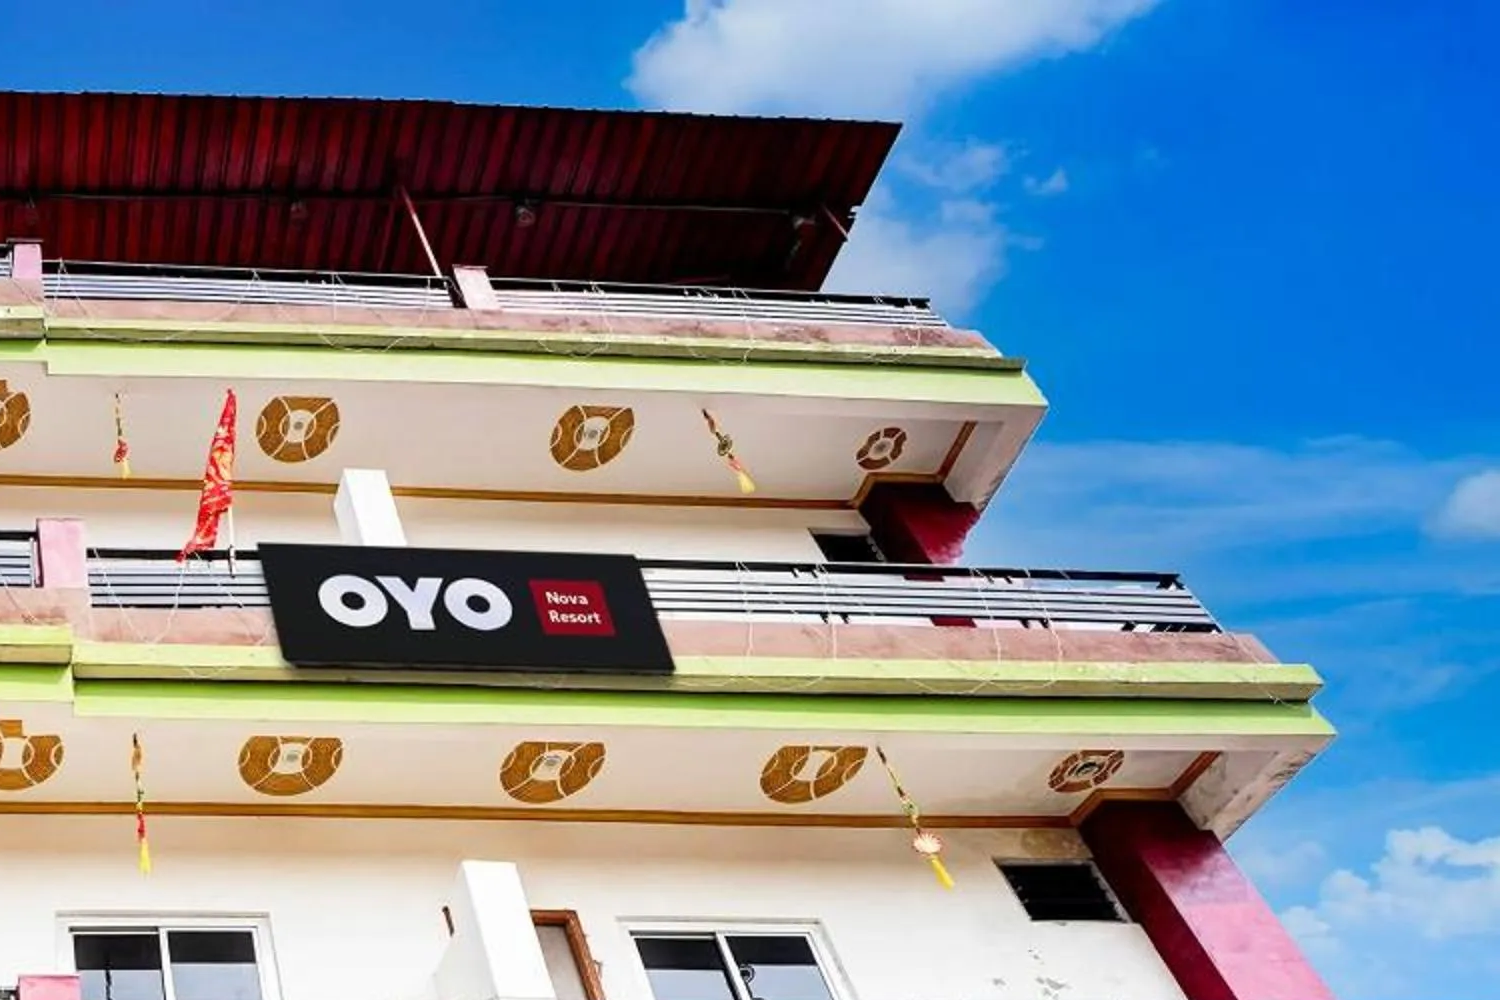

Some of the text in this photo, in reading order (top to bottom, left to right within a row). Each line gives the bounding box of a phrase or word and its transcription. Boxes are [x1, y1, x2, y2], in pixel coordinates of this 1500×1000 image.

[318, 574, 513, 631] OYO
[545, 591, 588, 606] Nova
[549, 608, 602, 624] Resort
